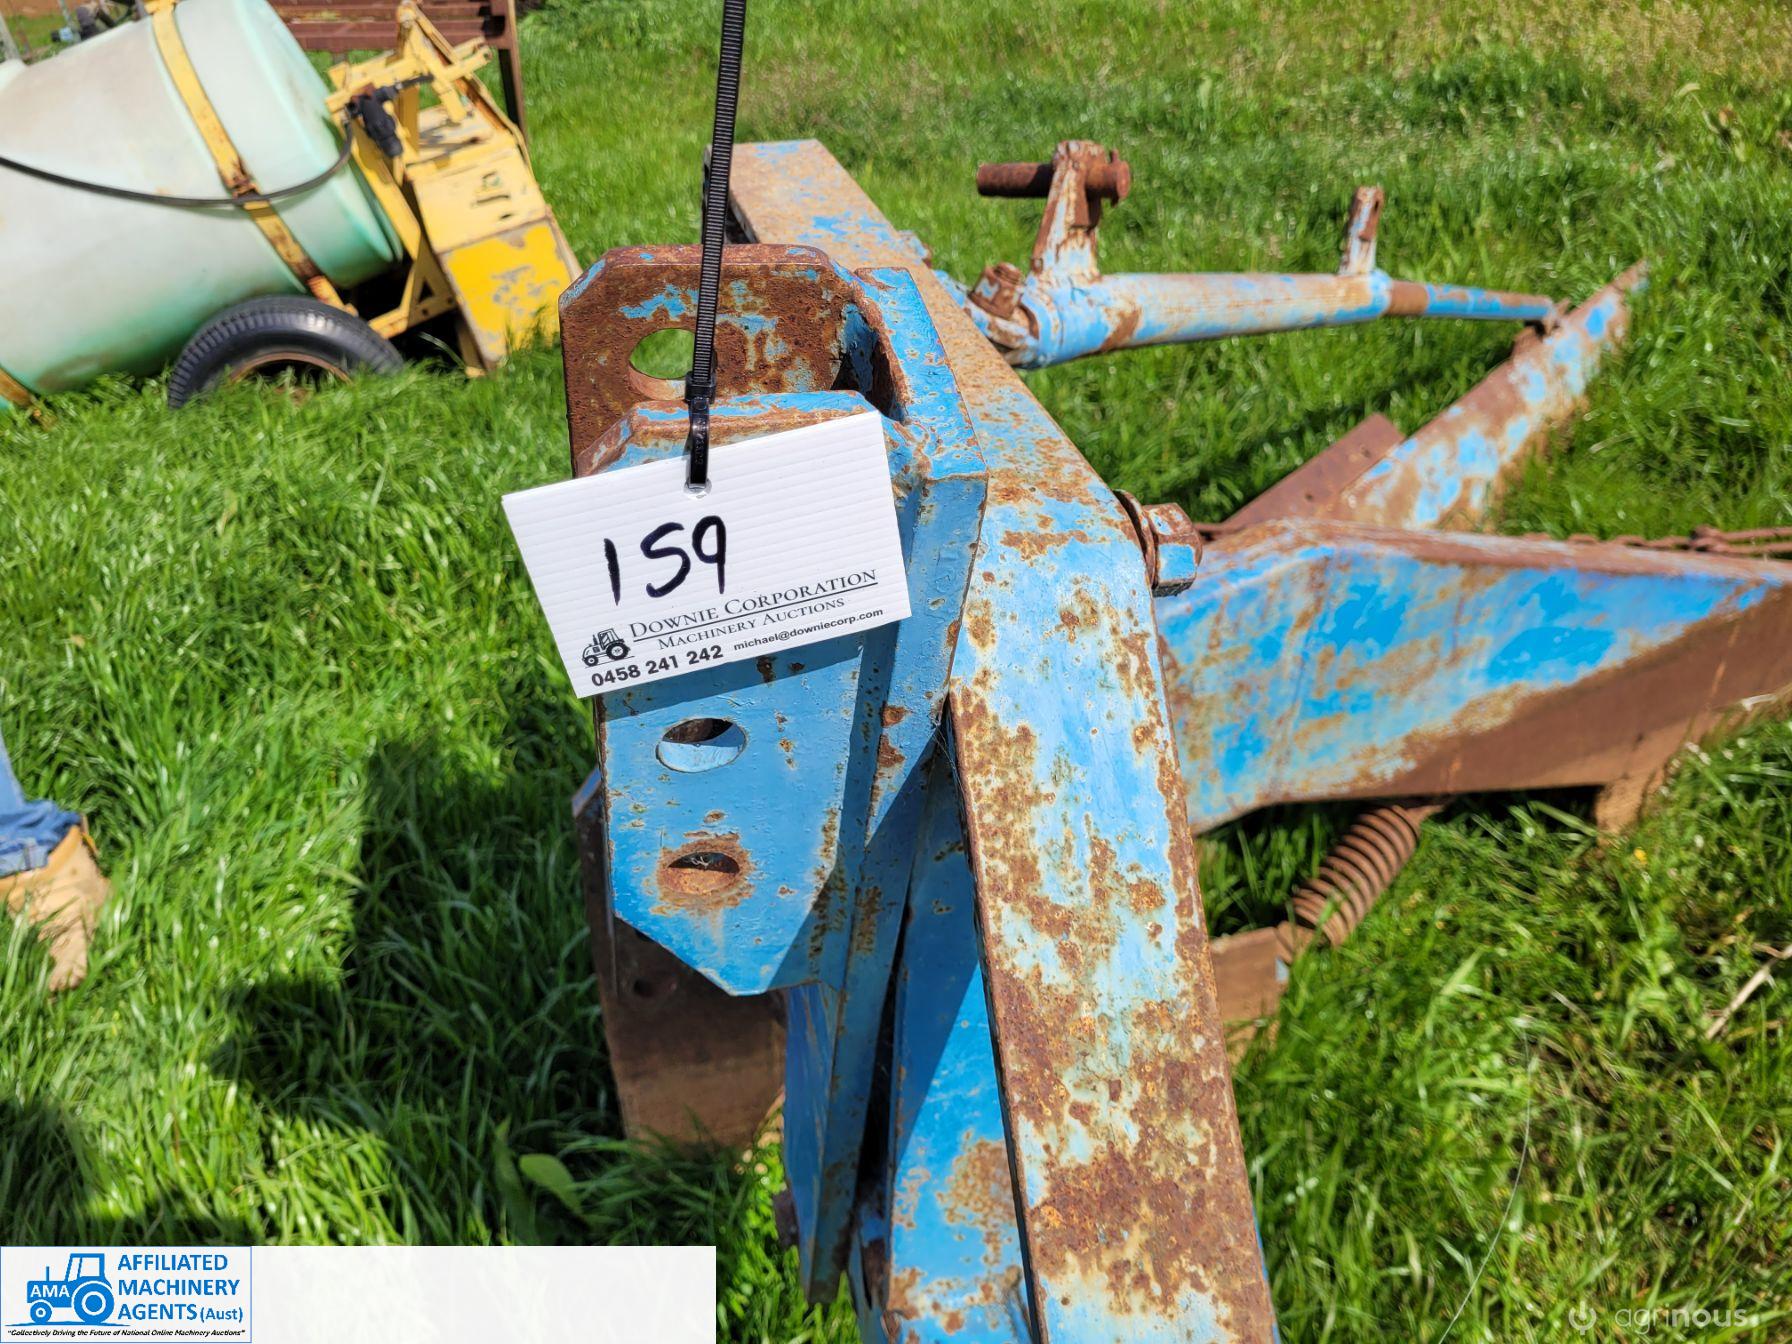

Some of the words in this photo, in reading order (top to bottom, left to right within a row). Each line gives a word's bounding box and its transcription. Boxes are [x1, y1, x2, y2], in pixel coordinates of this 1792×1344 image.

[603, 515, 727, 606] 159
[733, 608, 884, 651] michael@downiecorp.com
[591, 664, 641, 687] 0458
[645, 655, 679, 675] 241
[686, 644, 724, 666] 242
